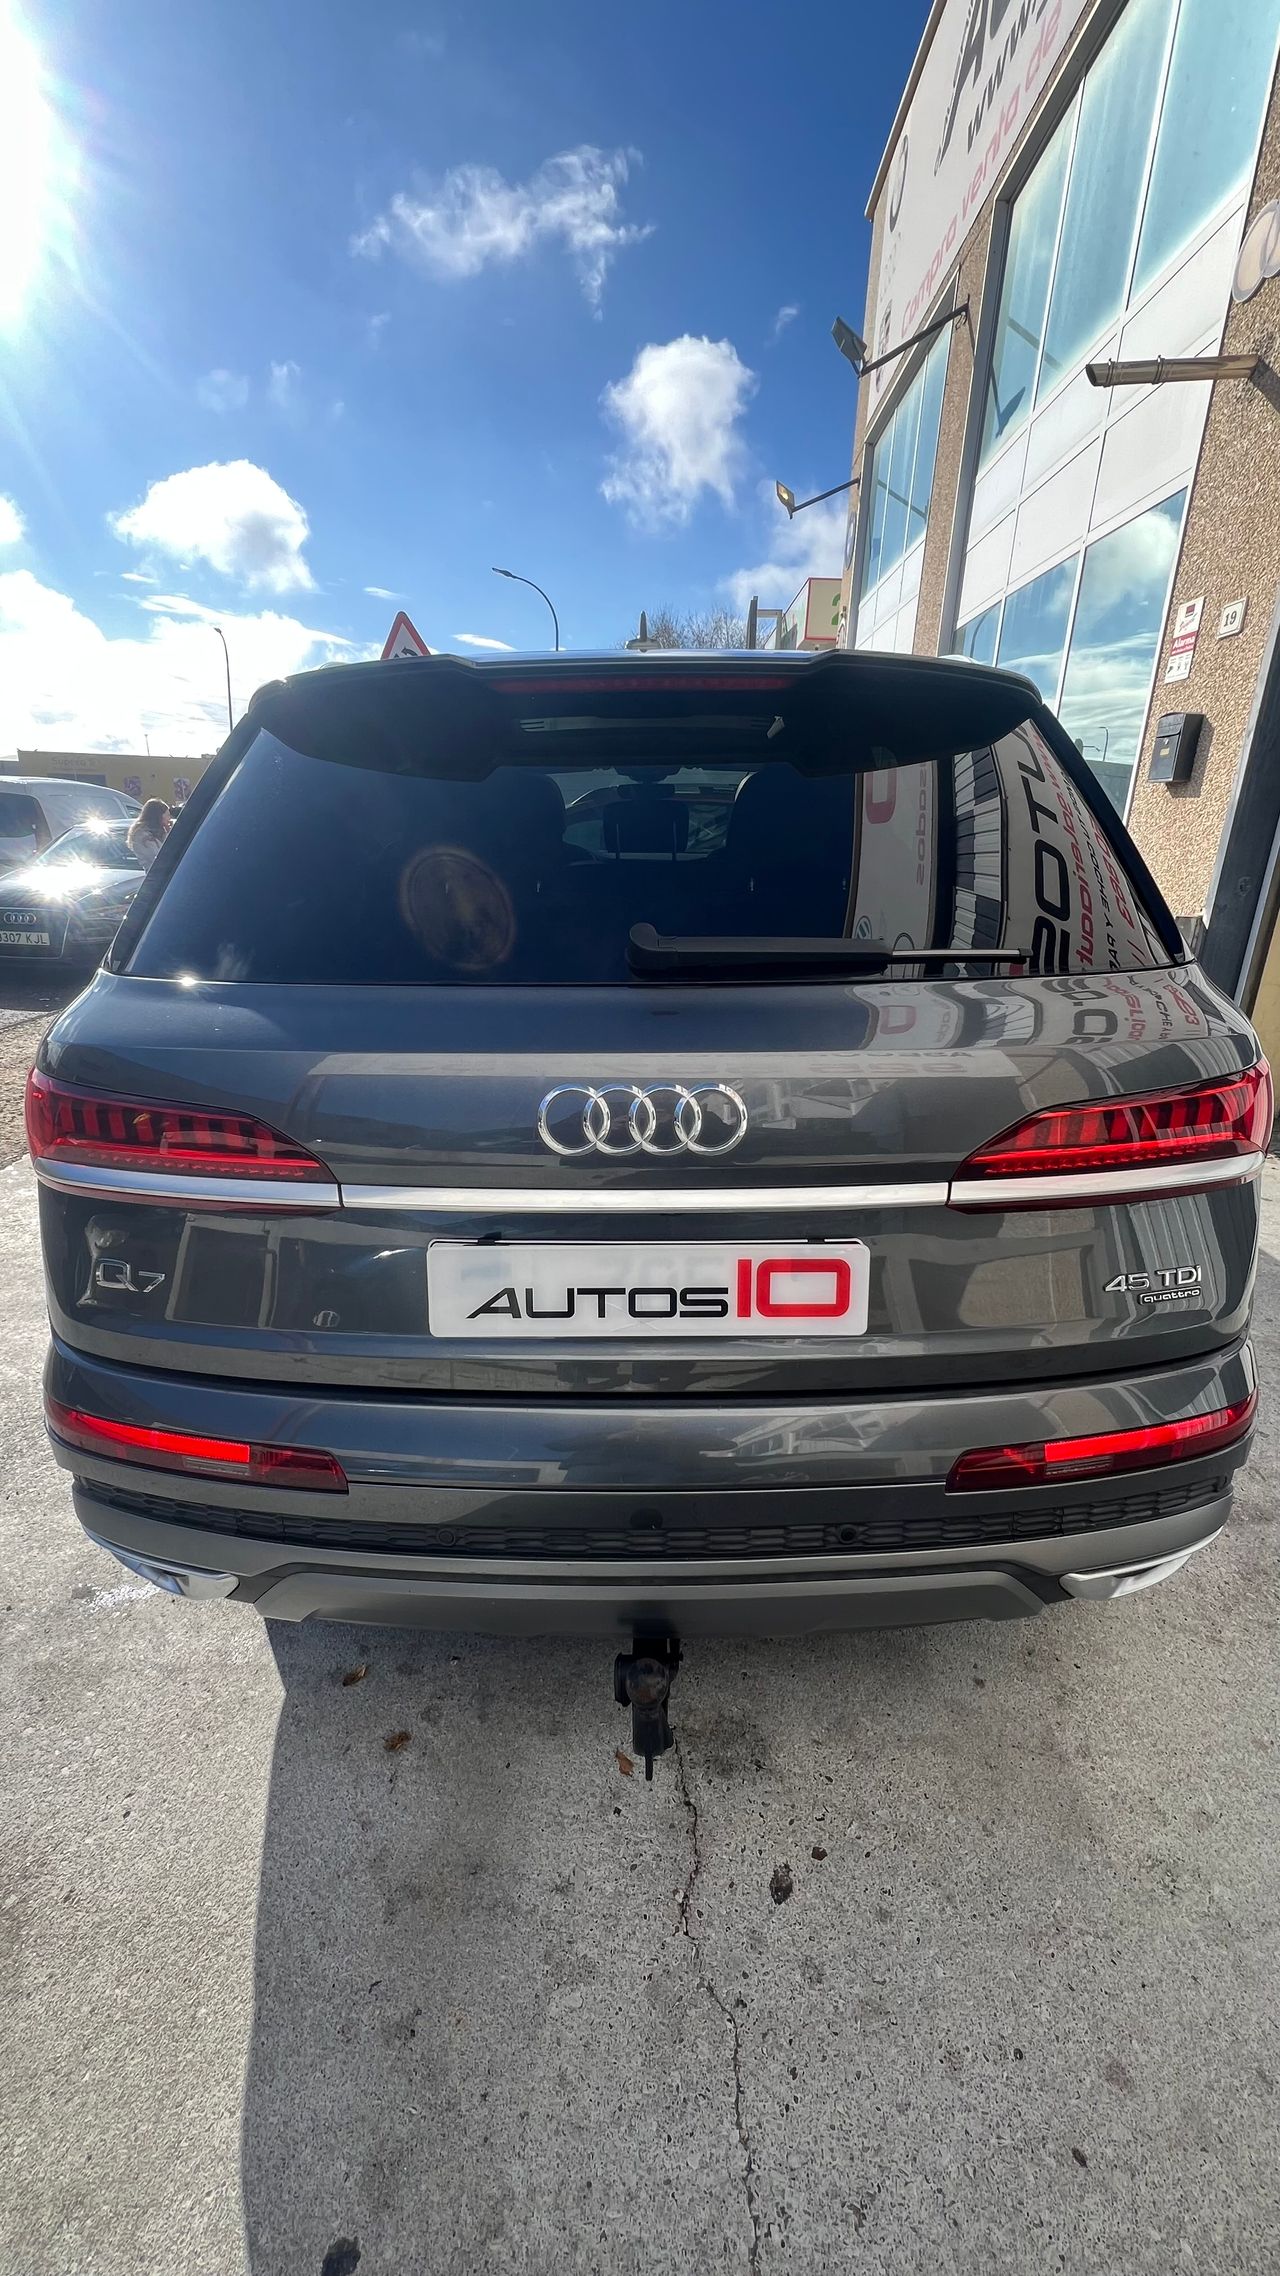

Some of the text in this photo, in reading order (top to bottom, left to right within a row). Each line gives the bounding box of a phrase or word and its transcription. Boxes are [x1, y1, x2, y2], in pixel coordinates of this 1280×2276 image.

[962, 84, 1021, 221] venta
[1024, 0, 1062, 93] de
[1224, 610, 1237, 628] 19
[26, 934, 47, 944] KJL
[96, 1258, 166, 1292] Q7
[1105, 1265, 1201, 1292] 45 TDI
[1144, 1289, 1200, 1303] quattro
